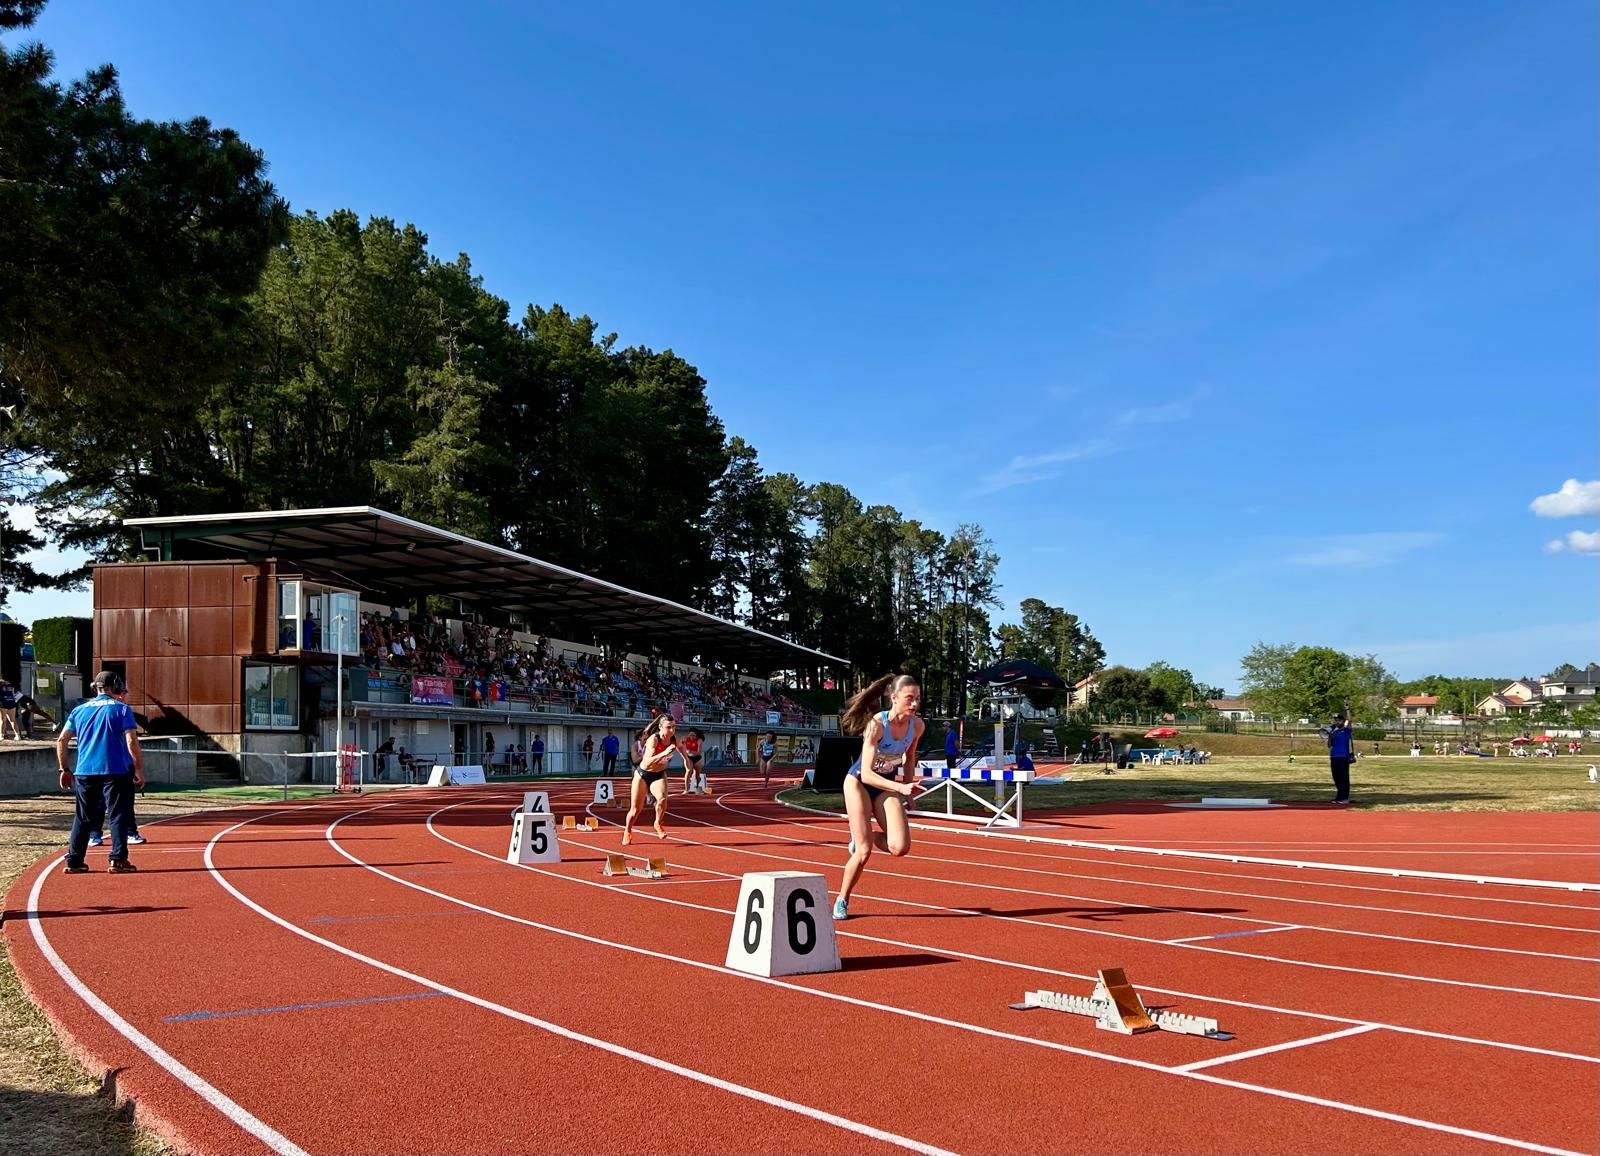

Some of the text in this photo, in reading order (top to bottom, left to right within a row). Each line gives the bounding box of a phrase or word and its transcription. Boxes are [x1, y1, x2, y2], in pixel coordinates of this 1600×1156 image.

[531, 795, 545, 813] 4
[599, 783, 609, 800] 3
[513, 819, 521, 853] 5
[531, 820, 548, 855] 5
[743, 888, 765, 954] 6
[786, 888, 817, 956] 6
